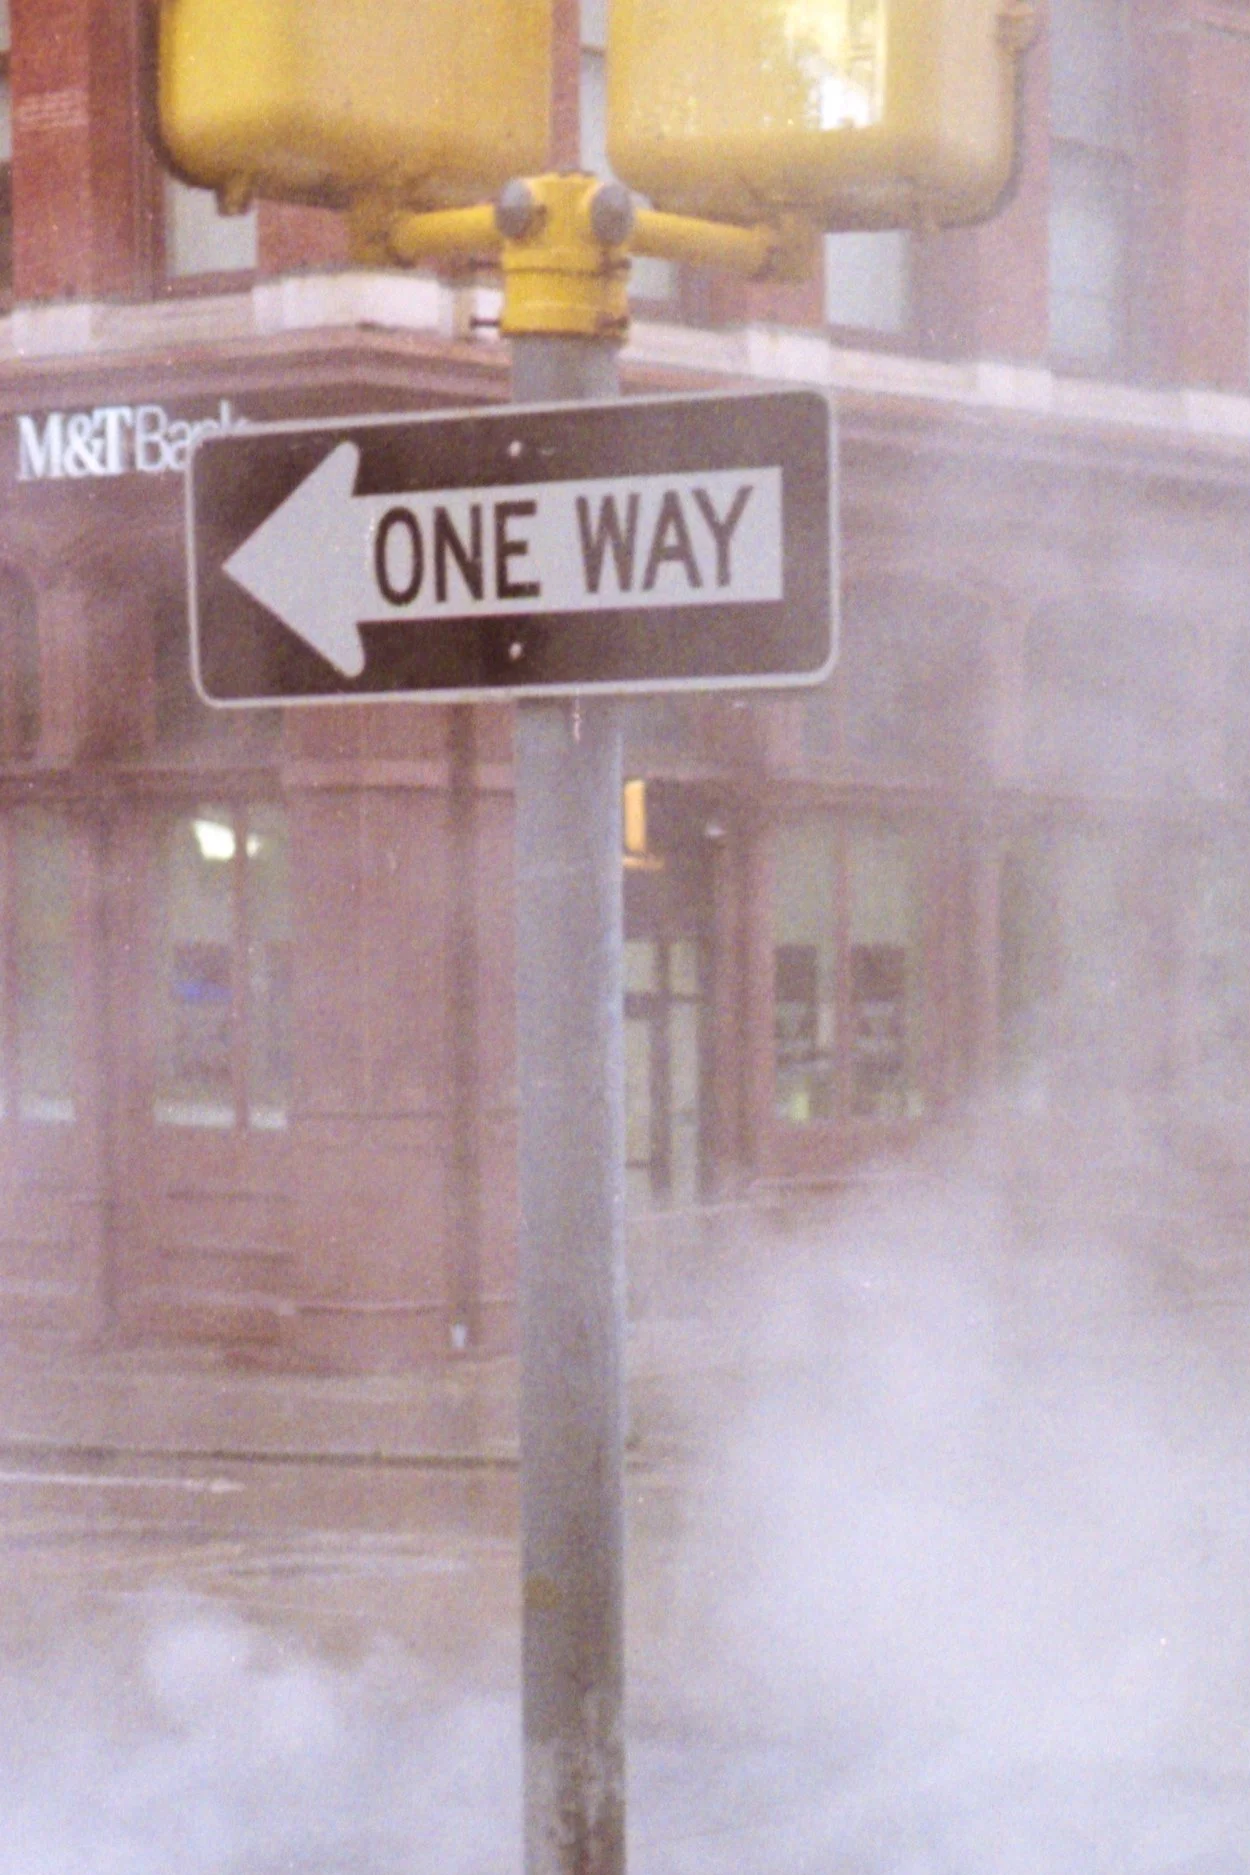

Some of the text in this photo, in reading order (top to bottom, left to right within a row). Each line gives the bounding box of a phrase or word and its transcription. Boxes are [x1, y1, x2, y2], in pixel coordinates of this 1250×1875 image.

[16, 399, 251, 482] M&T Ba
[374, 485, 754, 608] ONE WAY
